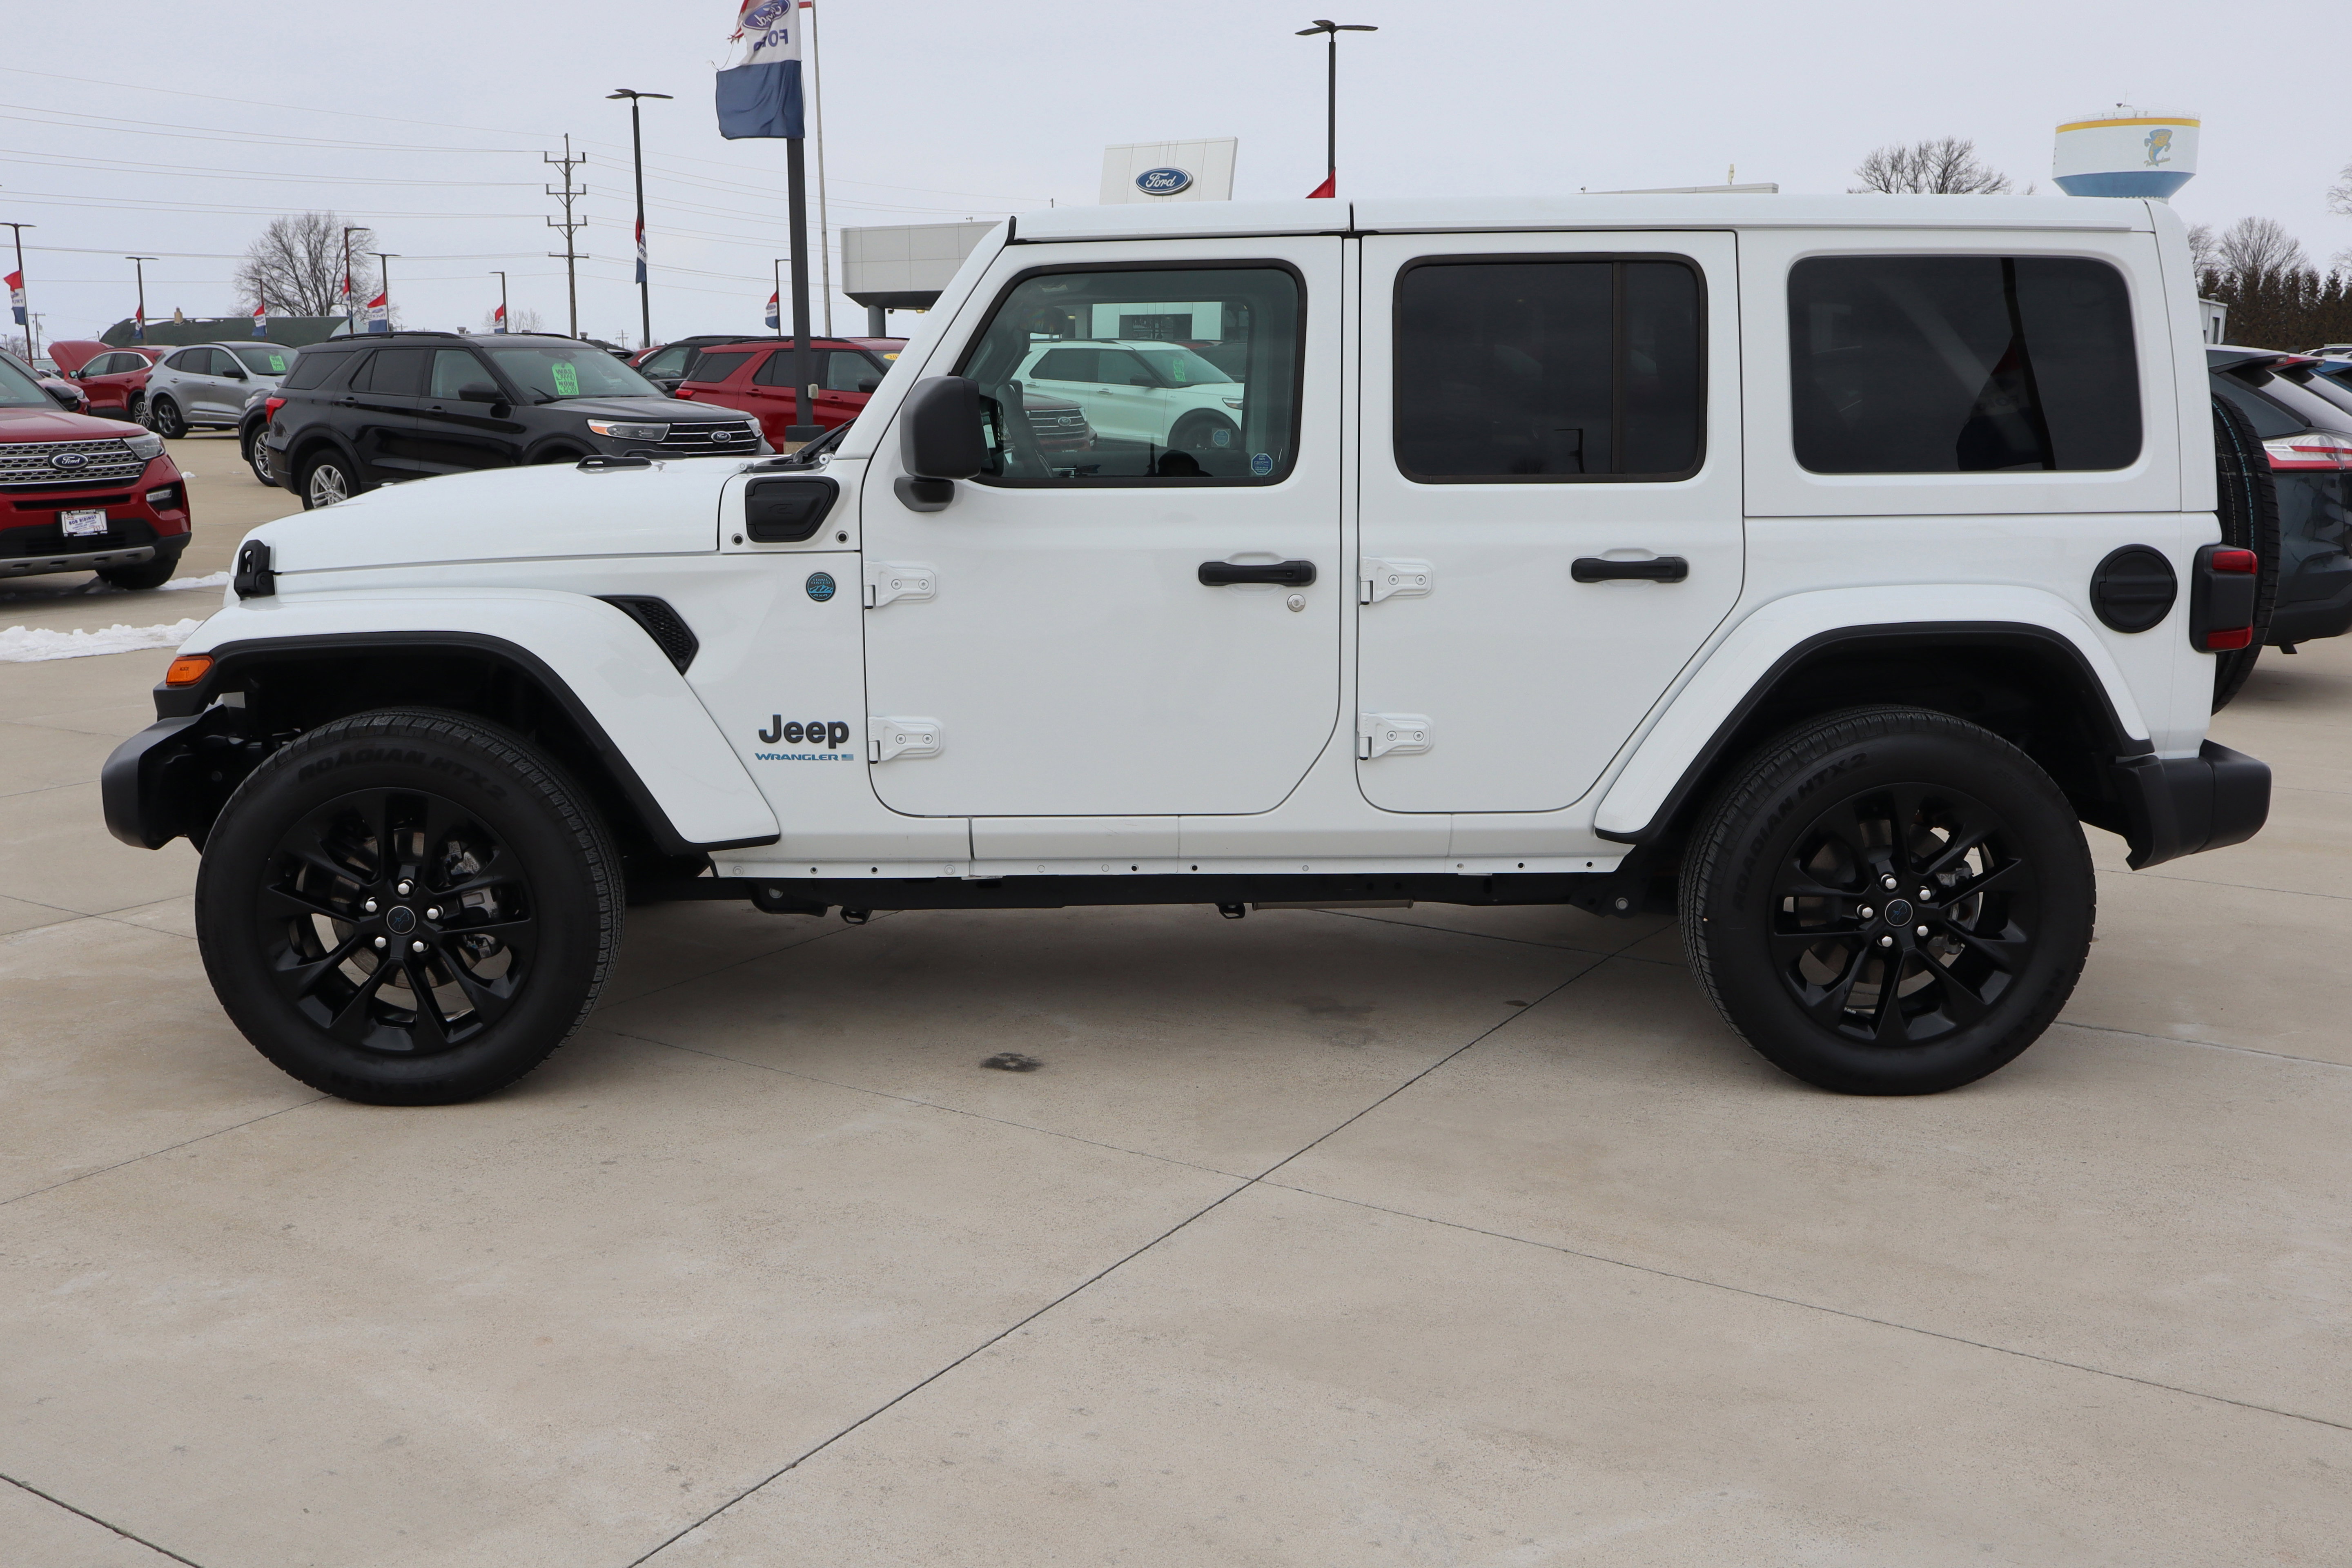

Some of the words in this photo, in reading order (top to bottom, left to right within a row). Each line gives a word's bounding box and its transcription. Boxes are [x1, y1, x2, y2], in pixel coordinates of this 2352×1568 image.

[1145, 172, 1177, 187] Ford
[758, 714, 849, 749] Jeep
[298, 748, 427, 782] ROADIAN
[1732, 796, 1794, 912] ROADIAN
